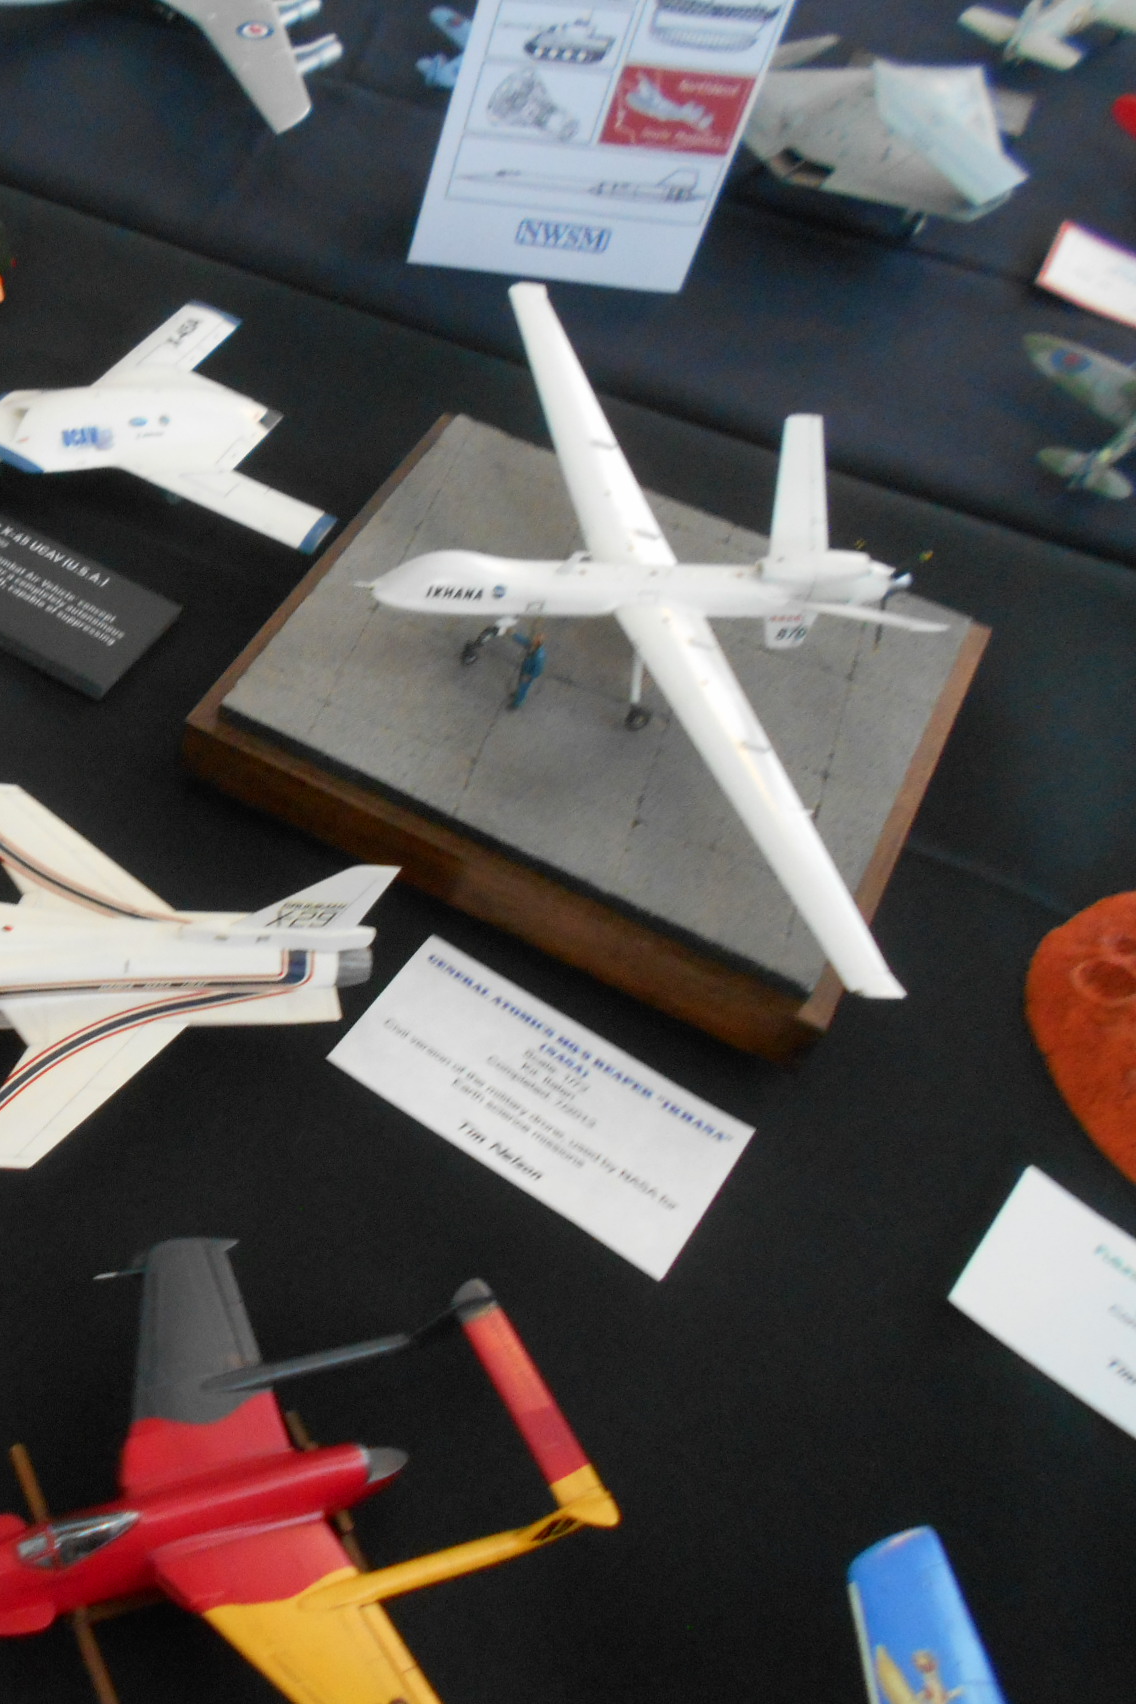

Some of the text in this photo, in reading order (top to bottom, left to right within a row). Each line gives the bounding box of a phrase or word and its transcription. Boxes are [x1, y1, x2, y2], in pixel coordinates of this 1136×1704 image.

[521, 219, 606, 250] NWSM
[62, 426, 99, 447] UCAV
[0, 526, 30, 545] X-45
[29, 541, 64, 562] UCAV
[61, 558, 109, 586] (U.S.A.)
[425, 585, 485, 601] IKHANA
[428, 954, 487, 995] GENERAL
[593, 1058, 652, 1097] REAPER
[539, 1043, 588, 1077] (NASA)
[410, 1037, 450, 1065] version
[465, 1071, 484, 1087] the
[485, 1085, 527, 1115] military
[568, 1140, 601, 1161] used
[599, 1157, 616, 1173] by
[619, 1169, 656, 1196] NASA
[658, 1194, 676, 1209] for
[452, 1078, 584, 1167] Earth science missions
[459, 1121, 541, 1179] Tim Nelson
